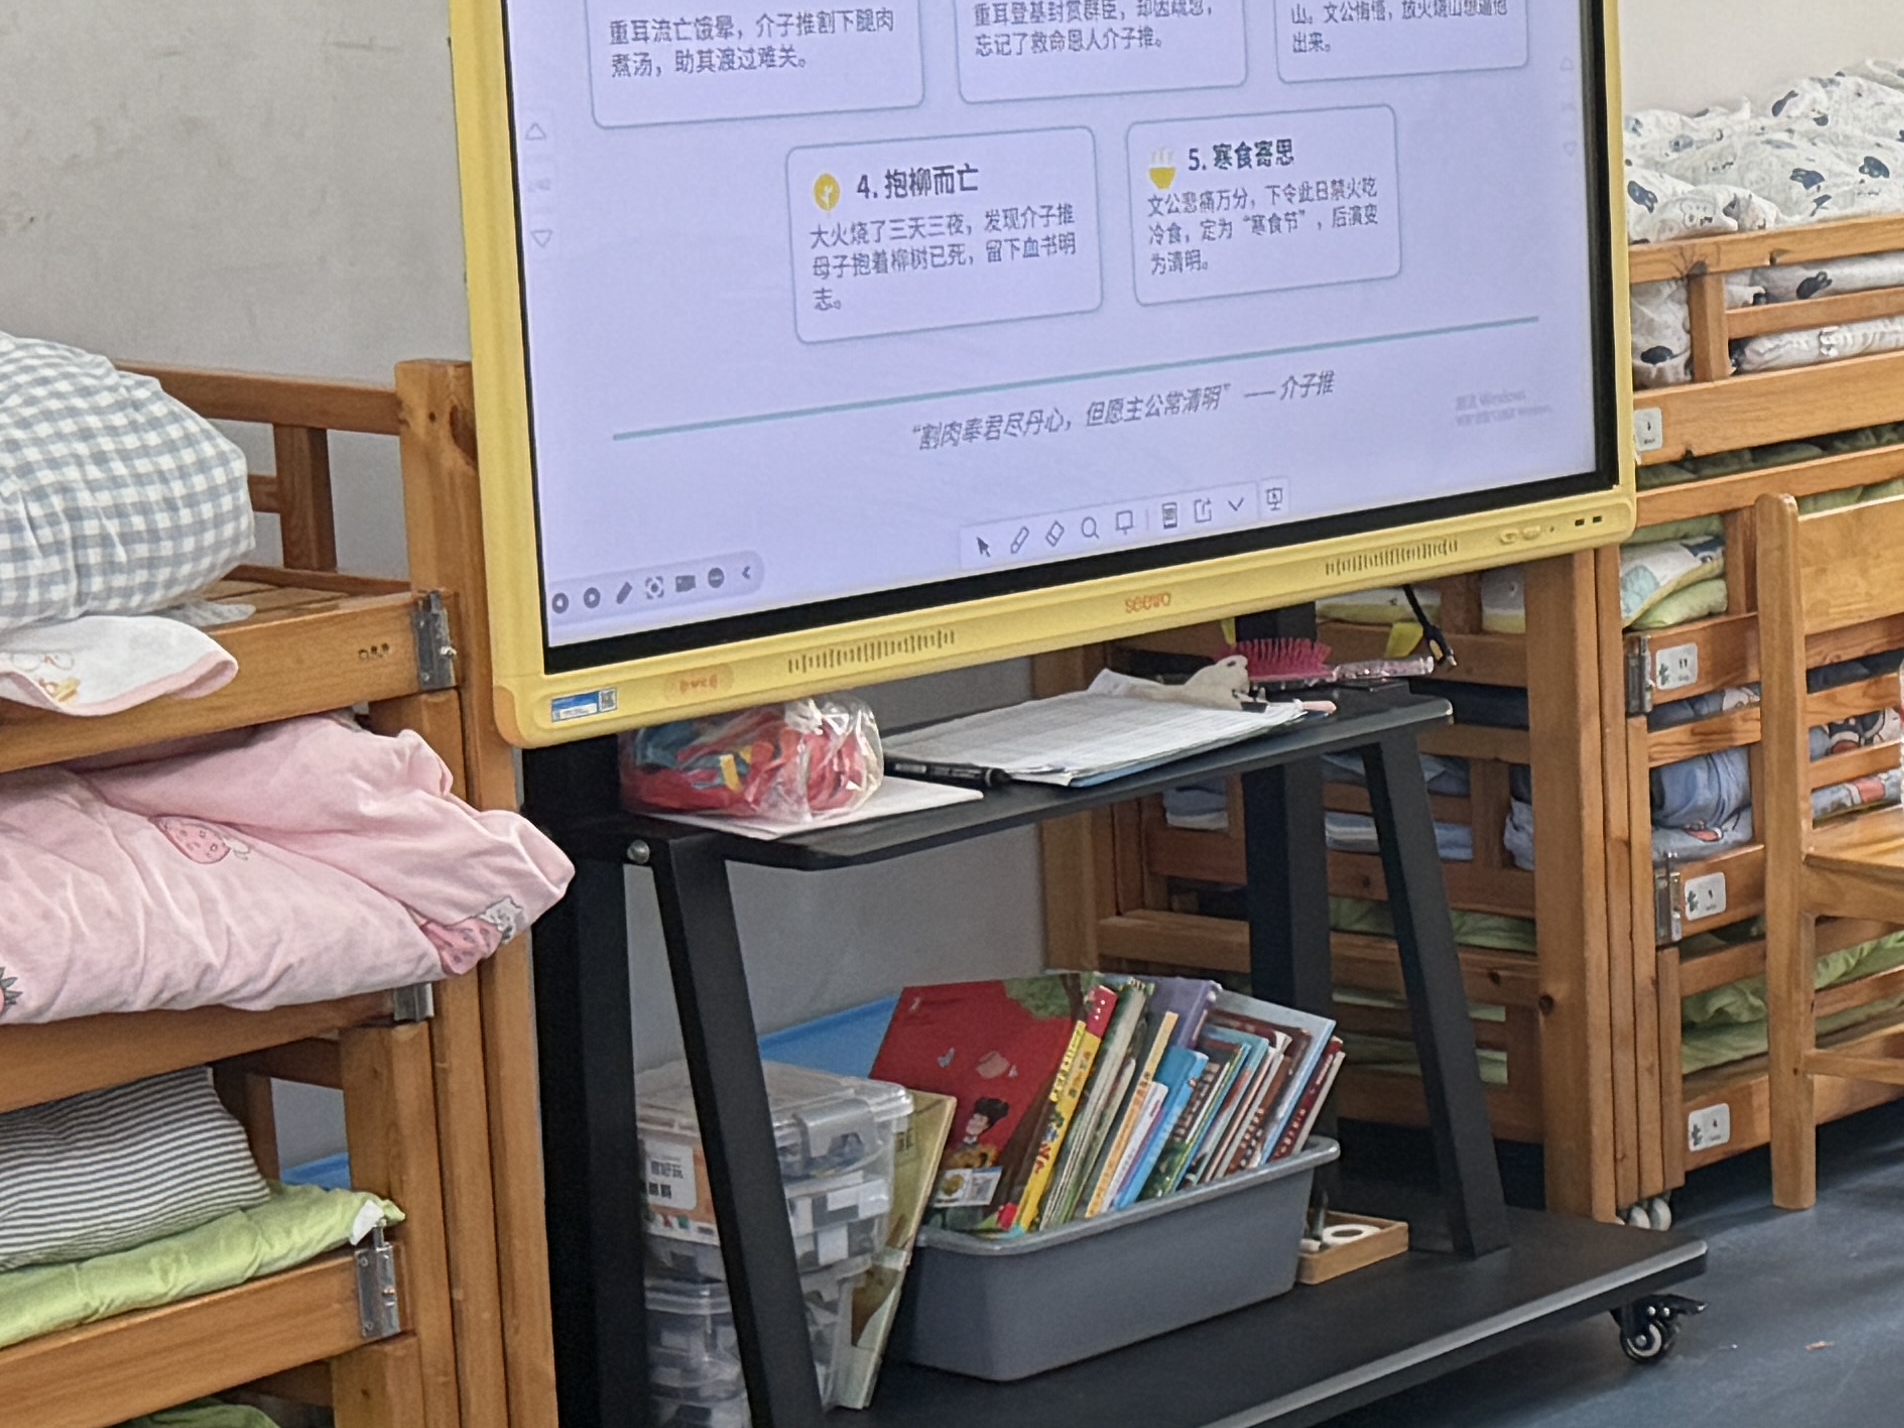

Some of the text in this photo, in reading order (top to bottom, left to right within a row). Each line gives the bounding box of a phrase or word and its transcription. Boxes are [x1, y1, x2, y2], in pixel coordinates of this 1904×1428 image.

[974, 23, 1162, 58] 忘记了救命恩人介子推。
[1292, 30, 1331, 54] 出来。
[1187, 137, 1295, 172] 5. 寒食寄思
[855, 162, 980, 200] 4. 抱柳而亡
[1146, 174, 1379, 218] 文公悲痛万分，下令此日禁火吃
[809, 202, 1075, 249] 大火烧了三天三夜，发现介子推
[812, 230, 1078, 281] 母子抱着柳树已死，留下血书明
[1150, 248, 1209, 276] 为清明。
[812, 286, 843, 312] 志。
